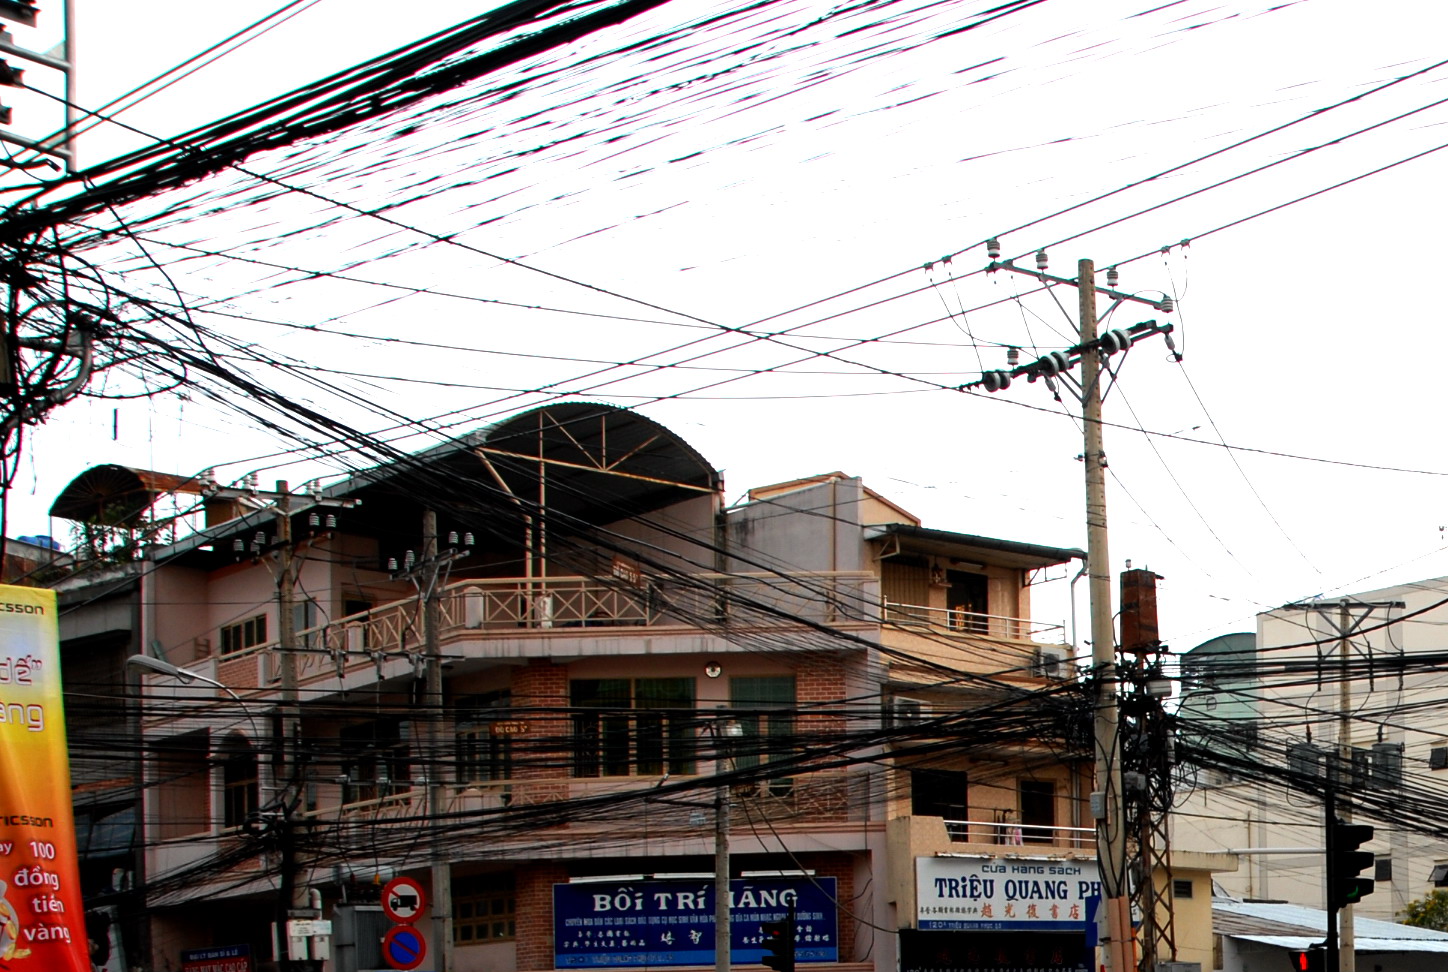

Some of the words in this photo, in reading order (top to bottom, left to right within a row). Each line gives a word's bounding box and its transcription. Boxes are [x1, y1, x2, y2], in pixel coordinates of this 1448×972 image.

[29, 841, 55, 860] 100
[1005, 878, 1068, 902] QUANG
[23, 922, 71, 944] vàng
